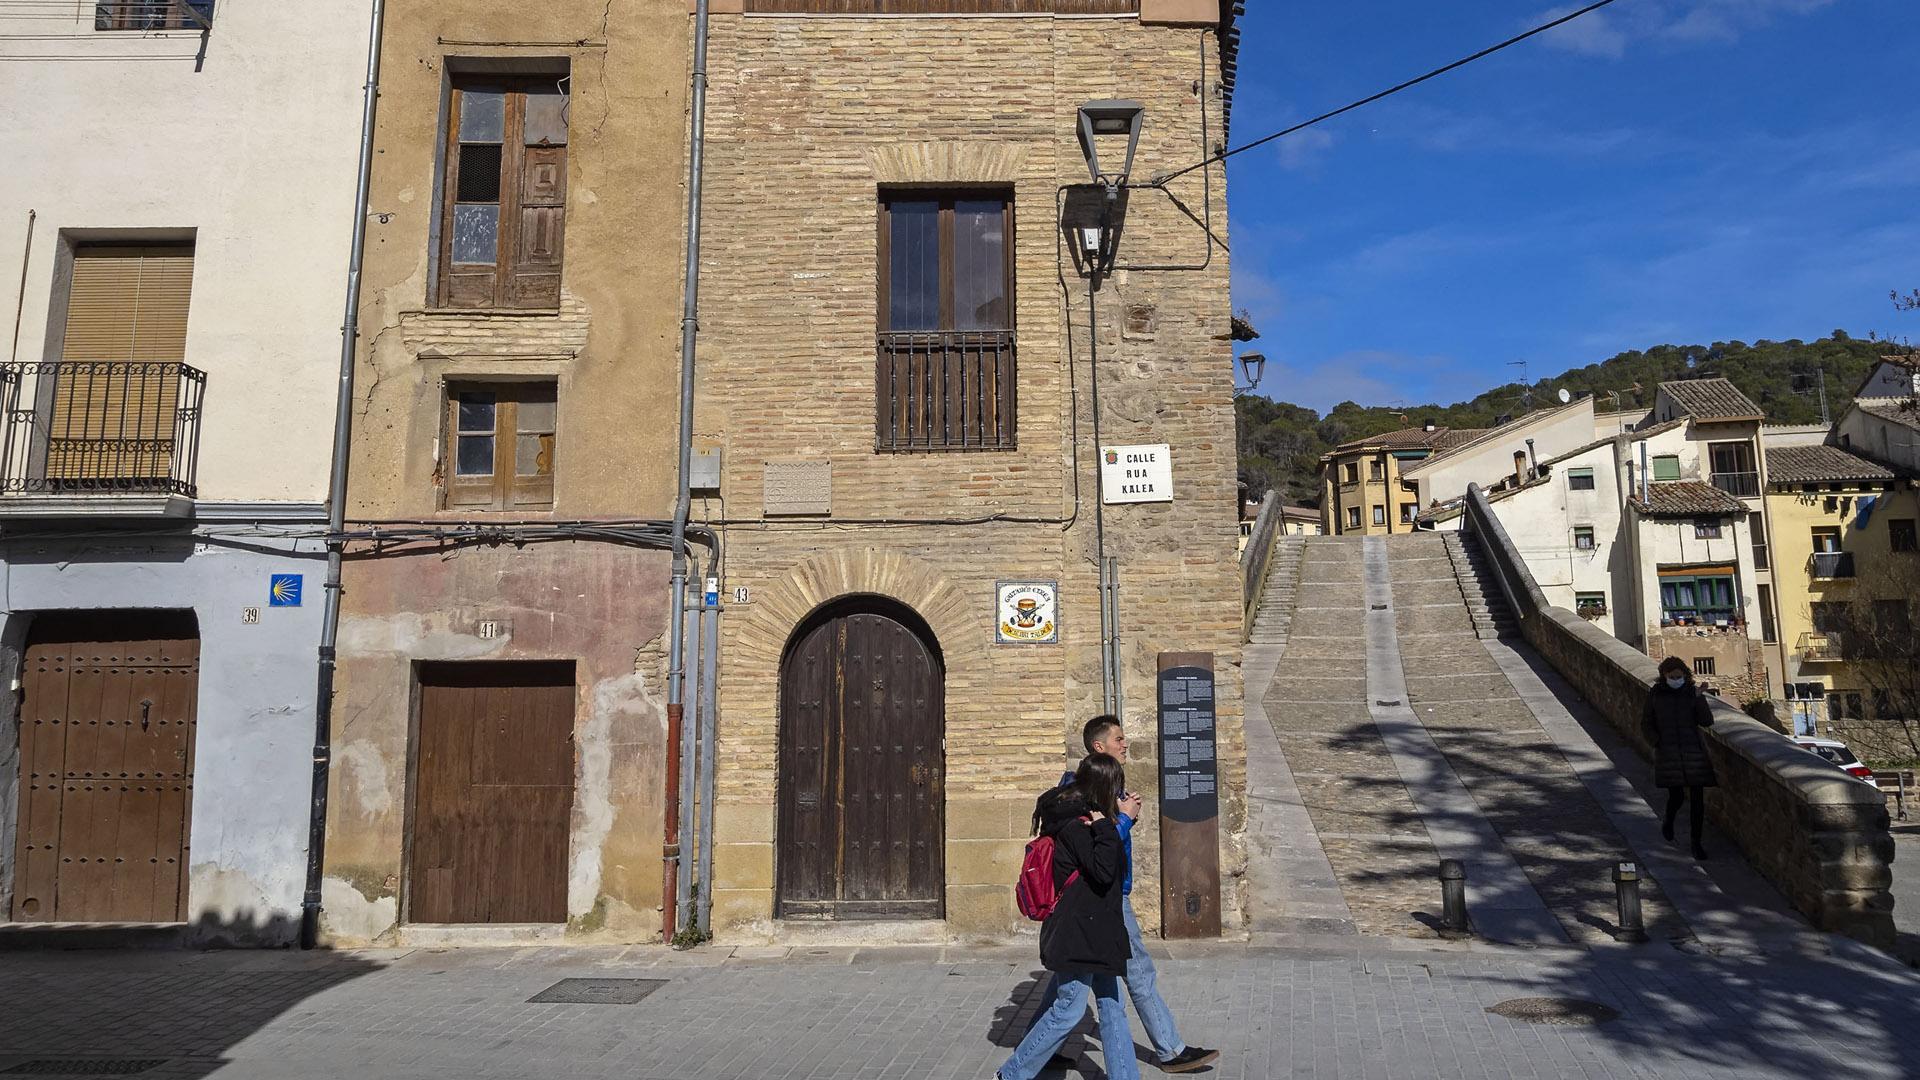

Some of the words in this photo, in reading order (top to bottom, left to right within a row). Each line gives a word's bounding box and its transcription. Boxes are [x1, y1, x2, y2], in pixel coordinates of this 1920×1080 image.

[1127, 453, 1155, 463] CALLE
[1126, 469, 1147, 478] RUA
[1122, 484, 1154, 494] KALEA
[735, 588, 748, 602] 43
[244, 608, 257, 622] 39
[481, 623, 494, 637] 41
